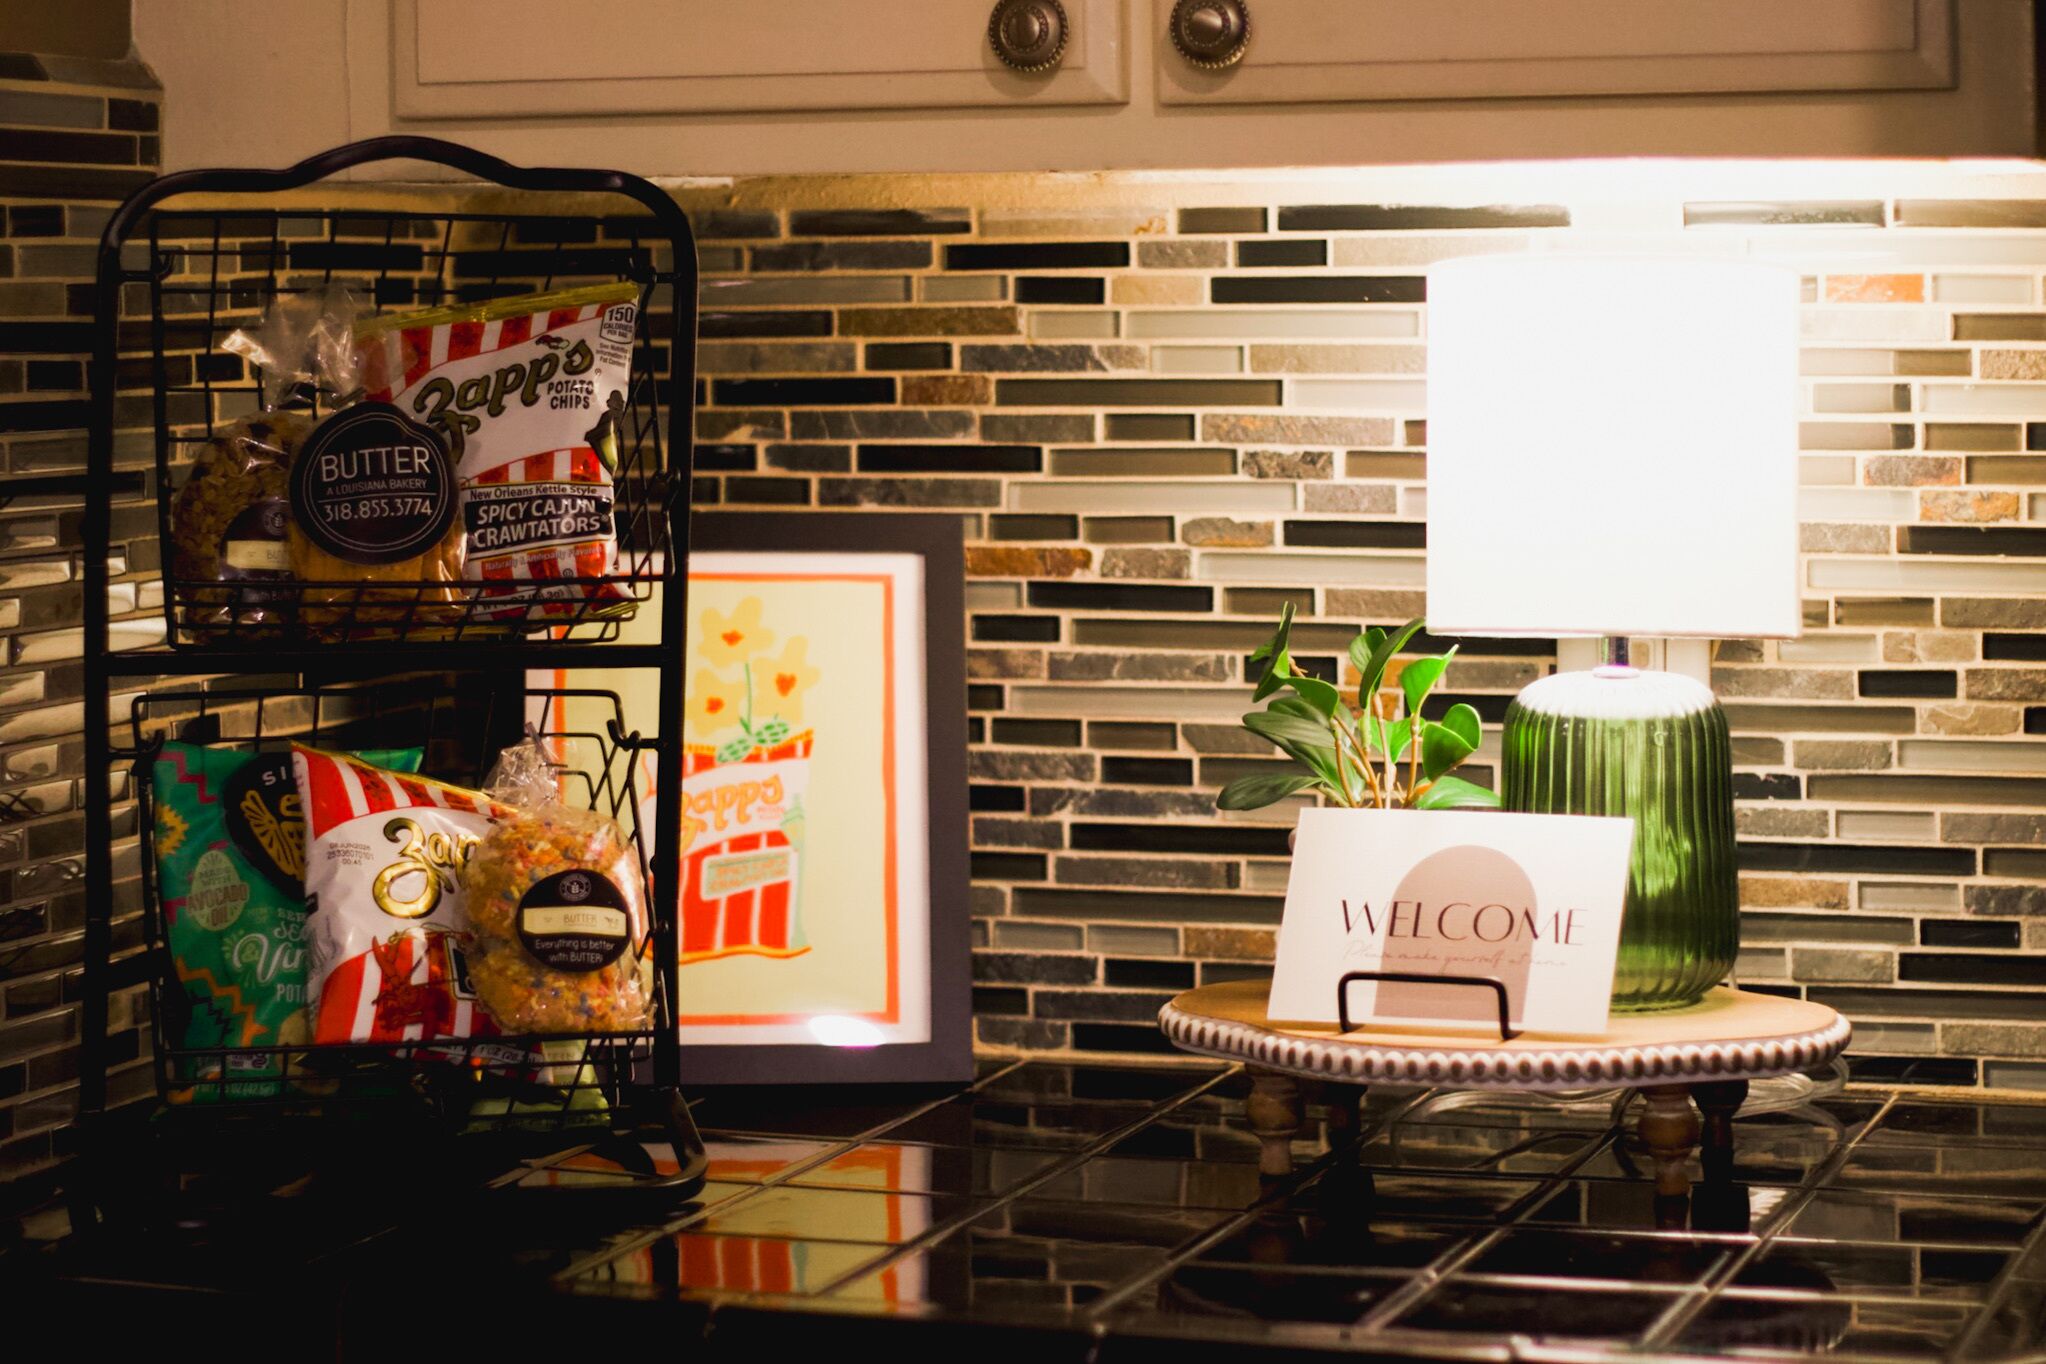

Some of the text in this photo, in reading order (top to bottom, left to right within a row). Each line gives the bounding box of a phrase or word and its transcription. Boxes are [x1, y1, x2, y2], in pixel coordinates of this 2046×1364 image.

[608, 306, 634, 323] 150
[547, 379, 595, 396] POTATO
[550, 395, 591, 410] CHIPS
[320, 446, 432, 483] BUTTER
[326, 478, 429, 497] A LOUISIANA BAKERY
[470, 484, 598, 501] New Orleans Kettle Style
[324, 498, 433, 523] 318.855.3774
[476, 497, 597, 526] SPICY CAJUN
[373, 817, 482, 919] Zap
[187, 883, 247, 912] AVOCADO
[1342, 899, 1588, 946] WELCOME
[535, 938, 617, 951] Everything is better
[549, 952, 568, 963] with
